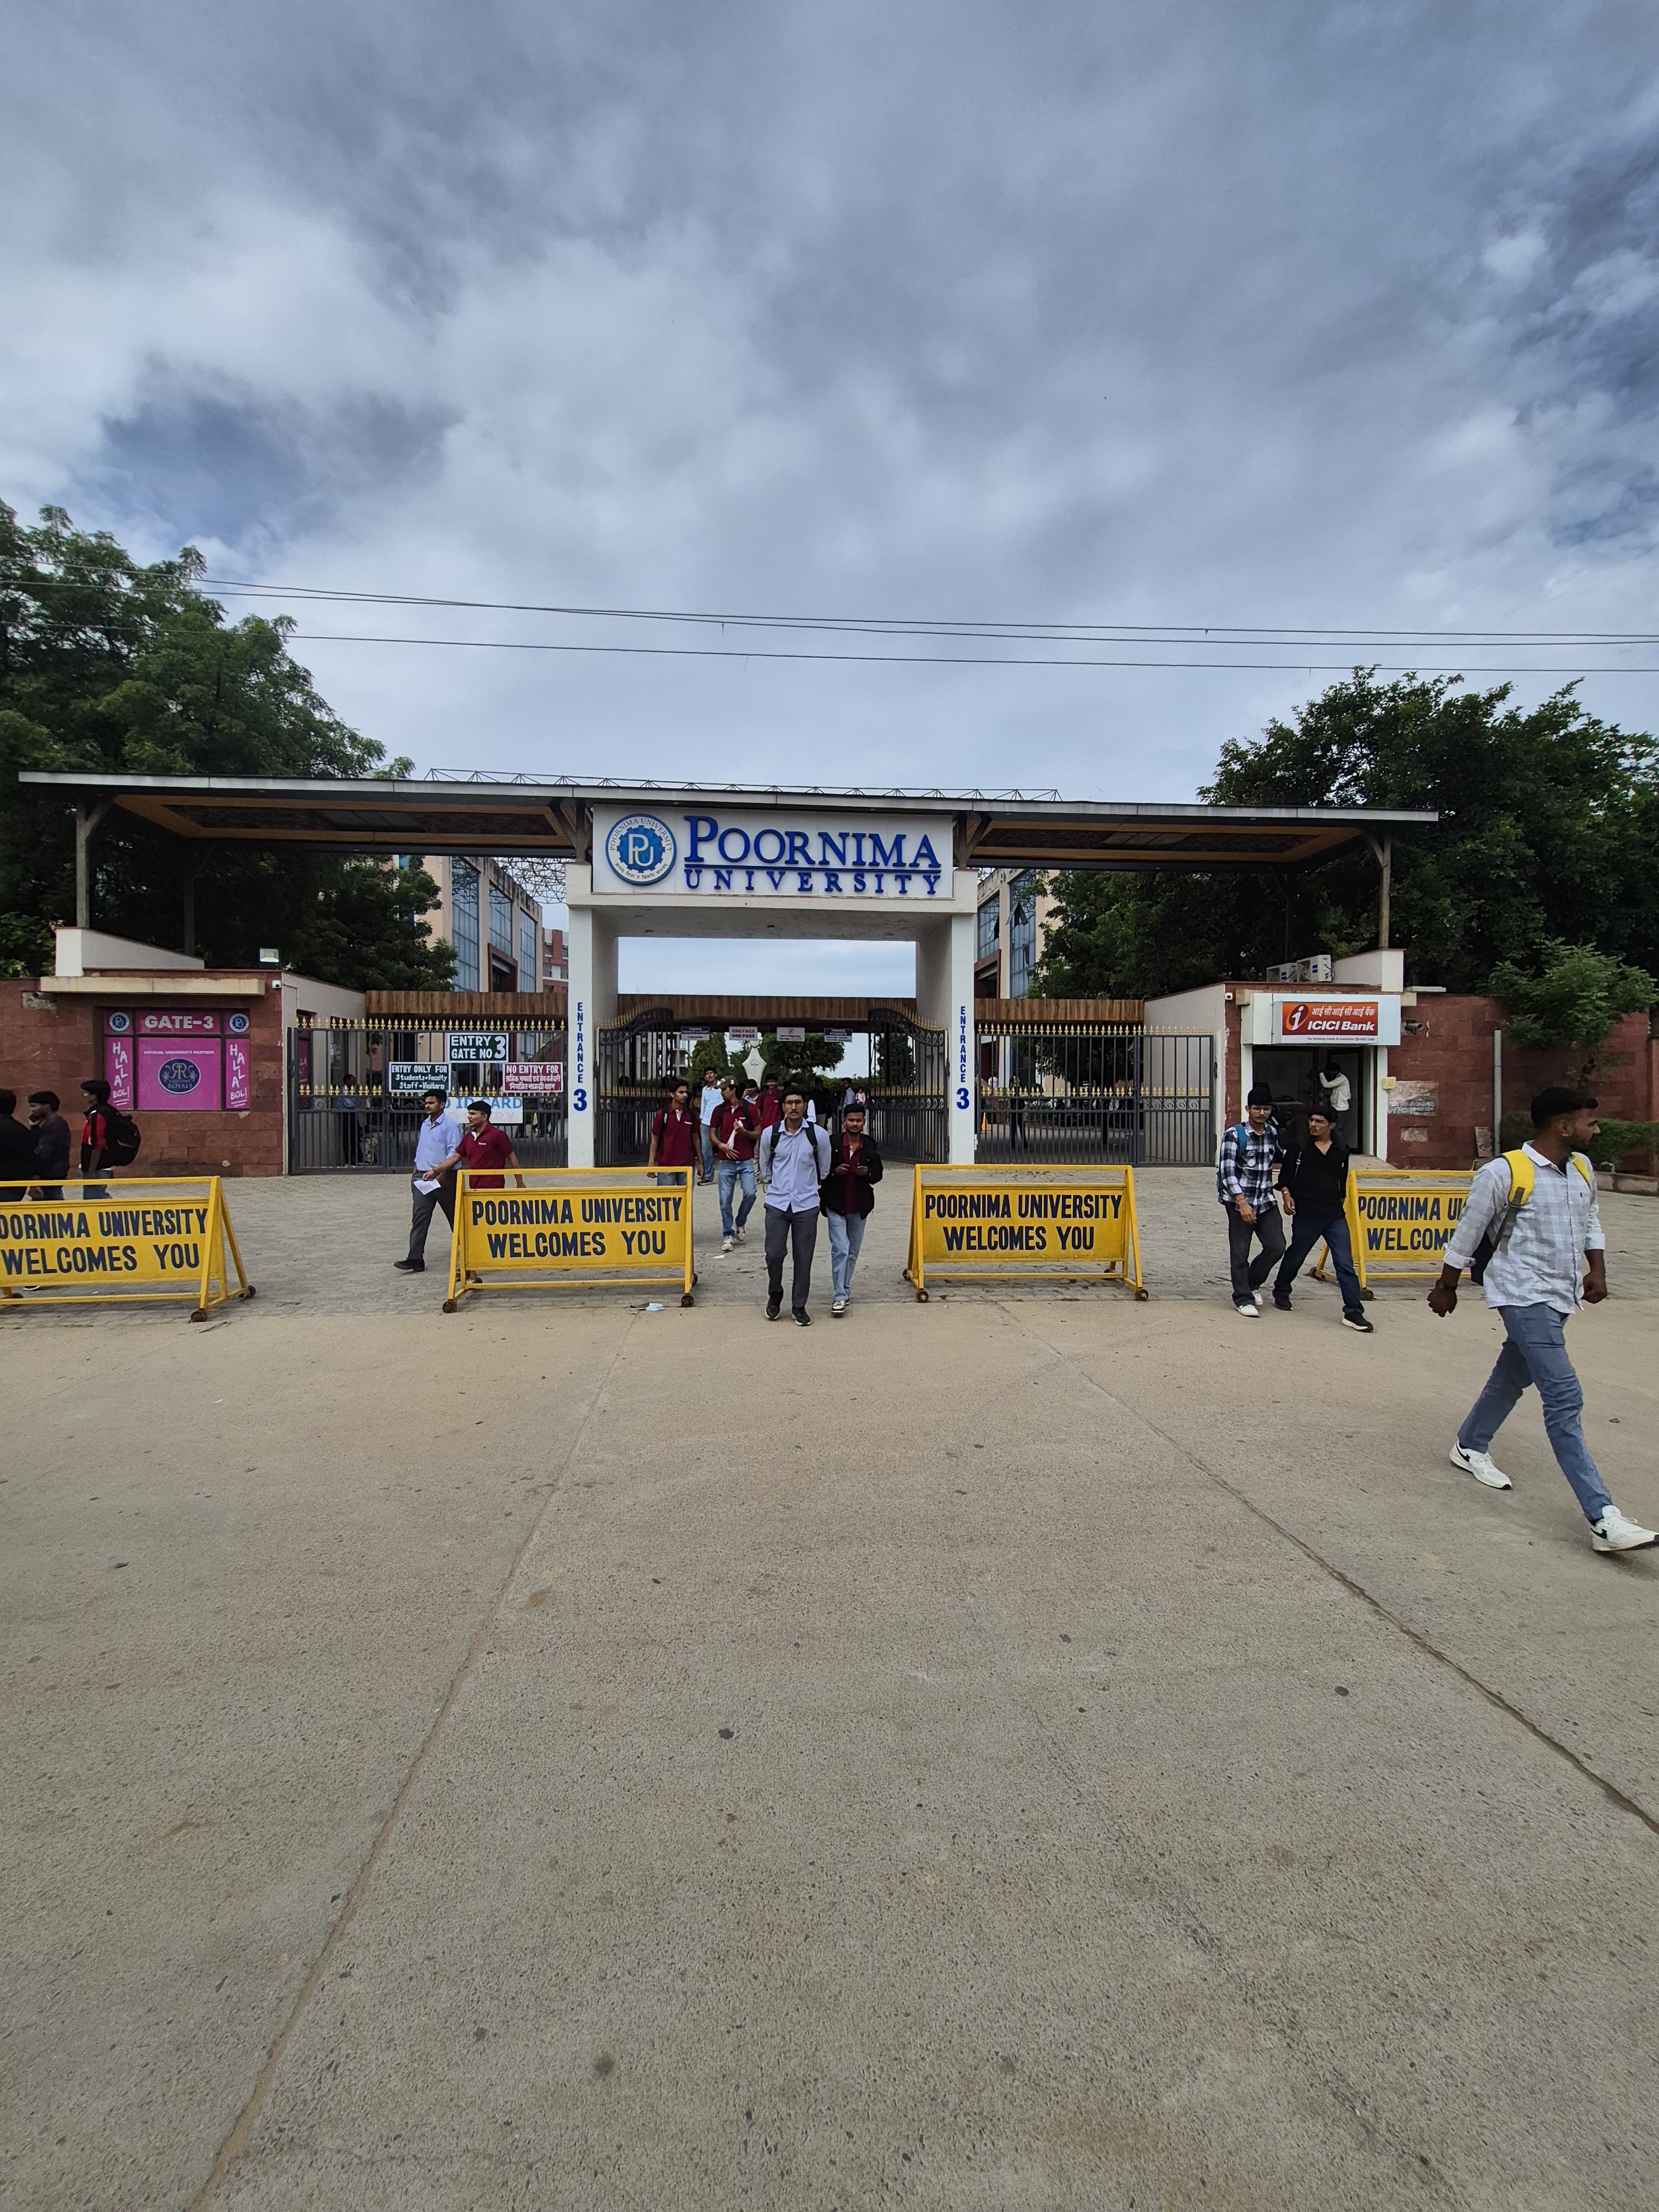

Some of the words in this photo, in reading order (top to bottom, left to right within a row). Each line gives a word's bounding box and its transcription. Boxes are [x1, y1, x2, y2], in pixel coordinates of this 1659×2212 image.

[609, 818, 639, 851] POORNIMA
[641, 818, 673, 852] UNIVERSITY
[684, 815, 941, 868] POORNIMA
[684, 868, 942, 895] UNIVERSITY
[145, 1015, 214, 1029] GATE-3
[1312, 1006, 1324, 1017] आई
[1324, 1005, 1332, 1016] सी
[1332, 1006, 1345, 1017] आई
[1344, 1006, 1352, 1016] सी
[1352, 1006, 1365, 1017] आई
[1307, 1021, 1340, 1030] ICICI
[1341, 1021, 1375, 1031] Bank
[451, 1036, 492, 1047] ENTRY
[494, 1036, 506, 1060] 3
[451, 1048, 477, 1060] GATE
[479, 1048, 492, 1059] NO
[506, 1065, 517, 1074] NO
[519, 1065, 544, 1074] ENTRY
[546, 1065, 559, 1074] FOR
[573, 1088, 587, 1112] 3
[956, 1087, 969, 1109] 3
[472, 1199, 573, 1225] POORNIMA
[581, 1197, 682, 1223] UNIVERSITY
[925, 1194, 1011, 1219] POORNIMA
[1018, 1194, 1123, 1219] UNIVERSITY
[1358, 1196, 1441, 1220] POORNIMA
[0, 1213, 91, 1240] OORNIMA
[98, 1208, 207, 1237] UNIVERSITY
[487, 1232, 606, 1258] WELCOMES
[621, 1230, 665, 1255] YOU
[943, 1225, 1047, 1250] WELCOMES
[1056, 1226, 1094, 1250] YOU
[1367, 1228, 1457, 1251] WELCOM
[1, 1245, 138, 1275] WELCOMES
[153, 1243, 199, 1270] YOU
